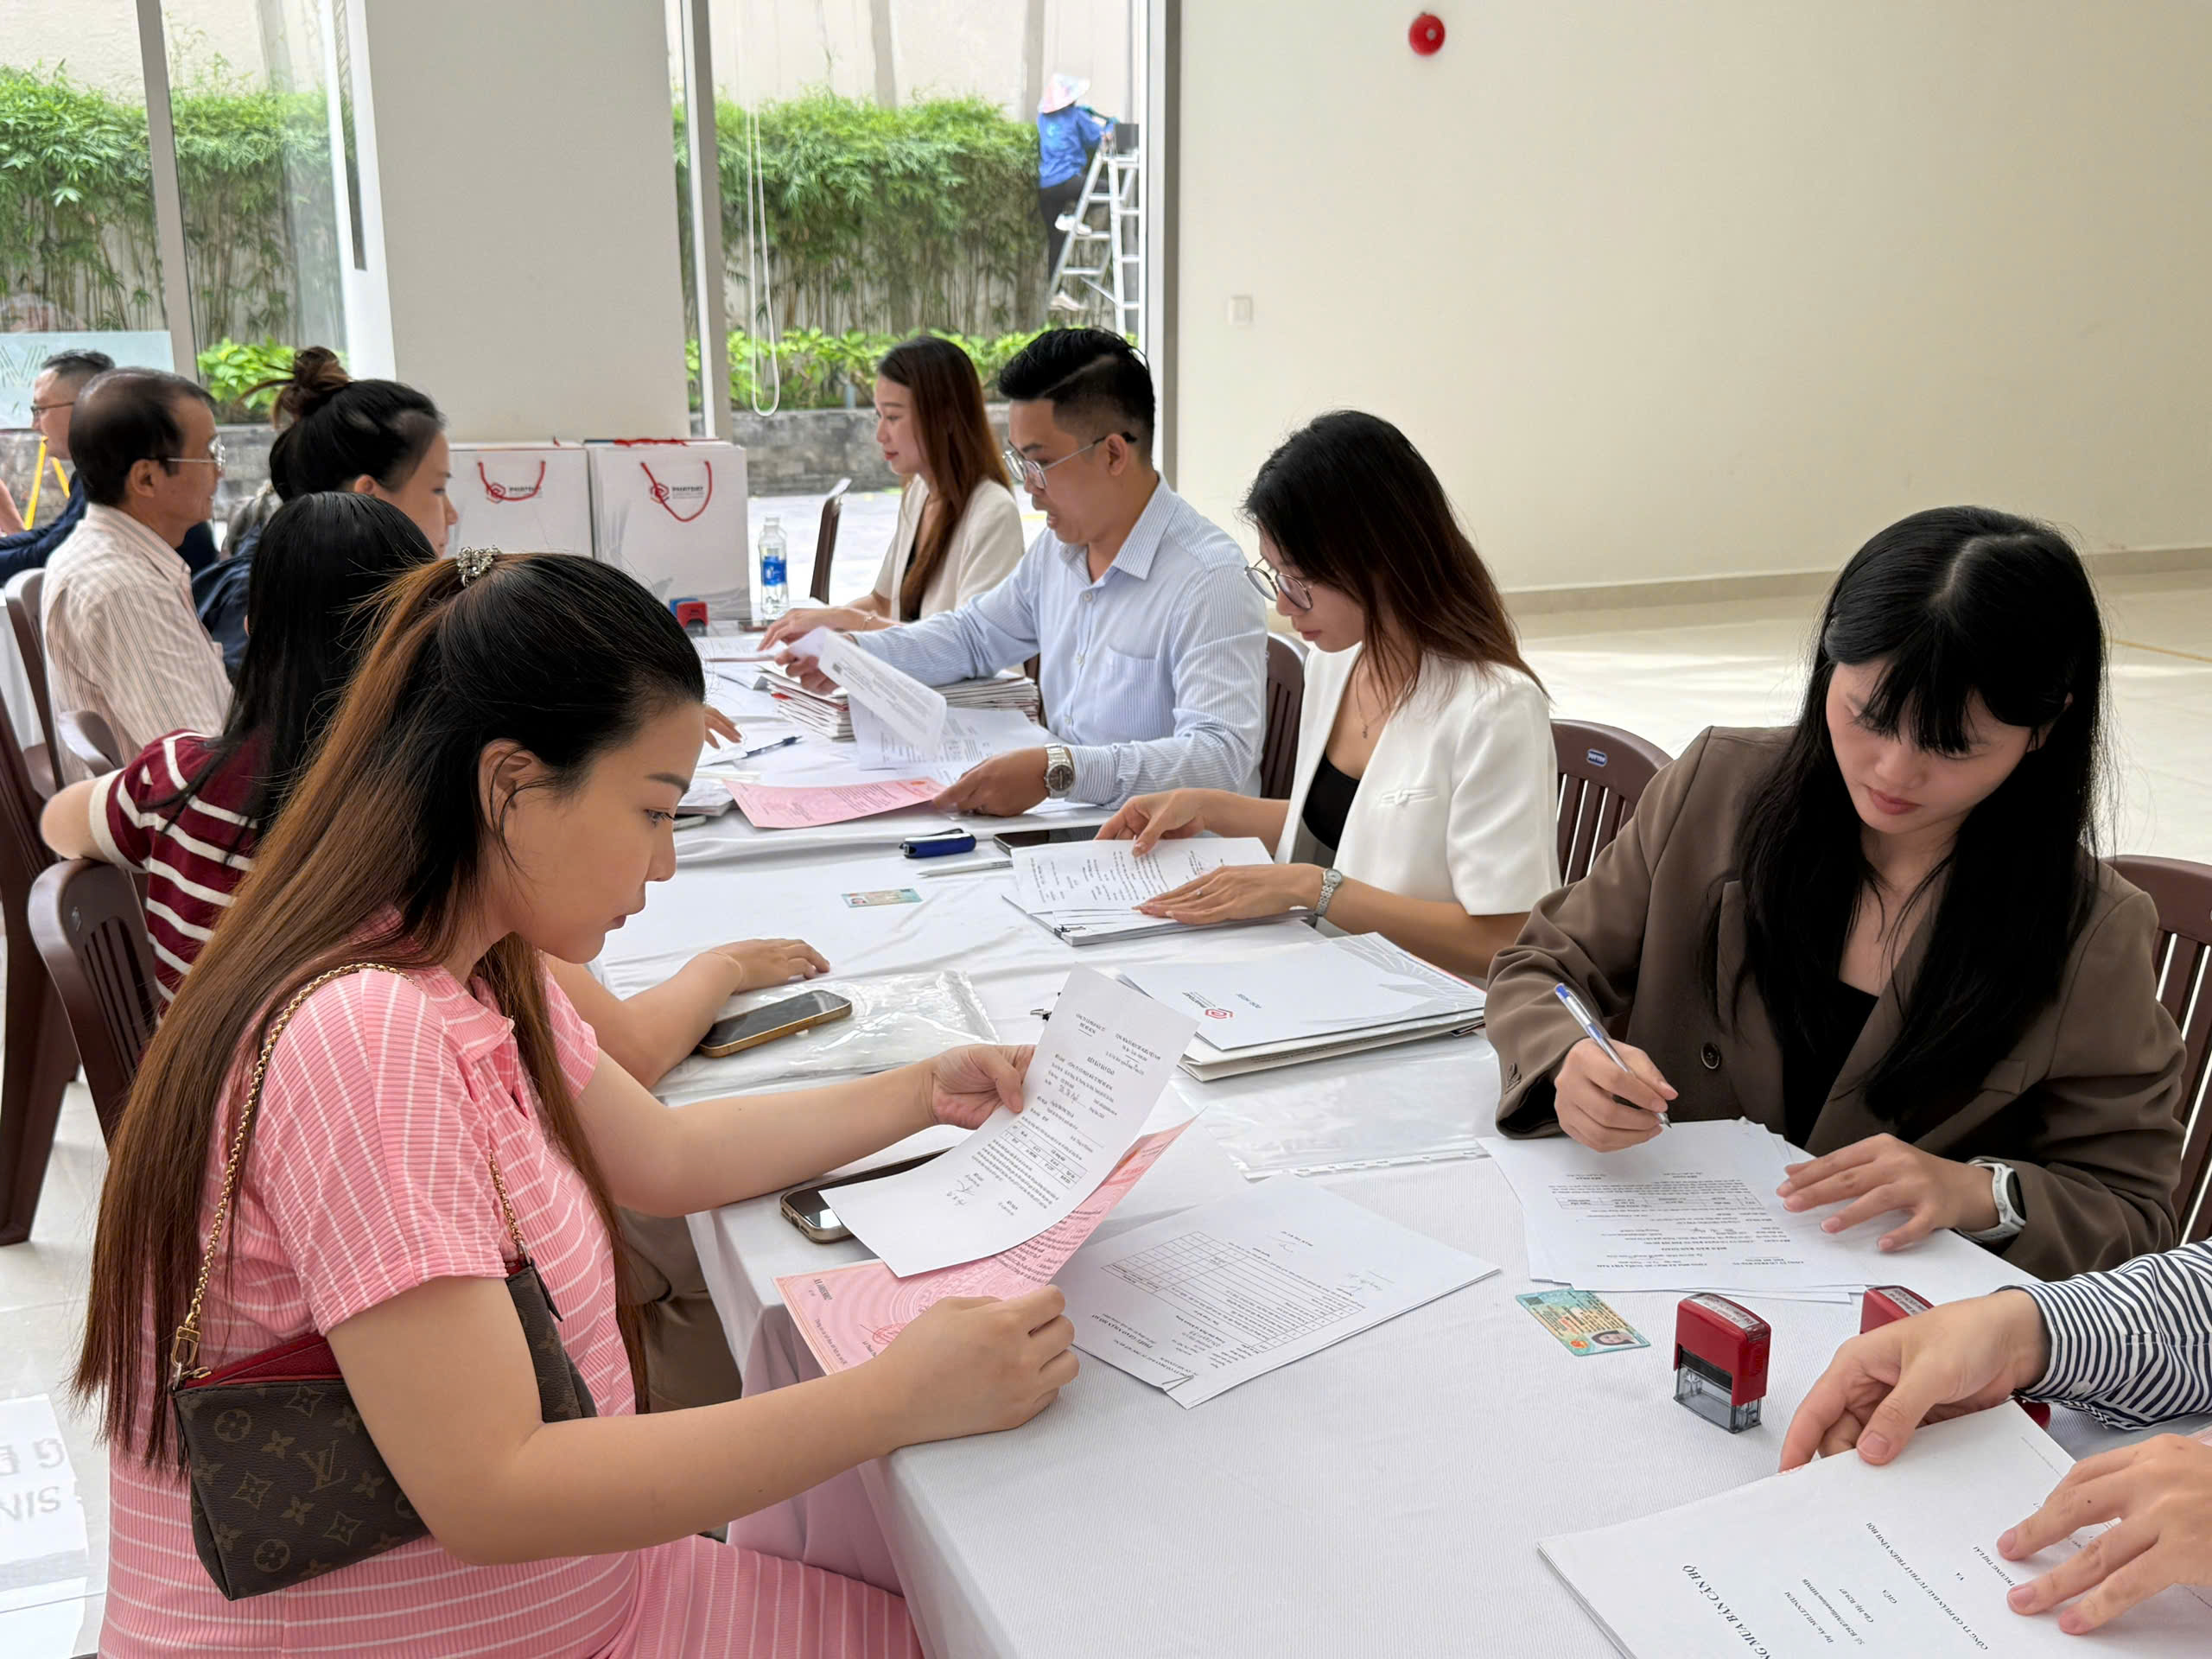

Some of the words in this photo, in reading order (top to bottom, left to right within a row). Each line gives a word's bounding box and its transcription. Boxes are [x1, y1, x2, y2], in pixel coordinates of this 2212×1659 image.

[1695, 1580, 1719, 1600] CĂN
[1714, 1602, 1738, 1622] BÁN
[1784, 1592, 1816, 1625] MILLENNIUM
[1735, 1624, 1761, 1646] MUA
